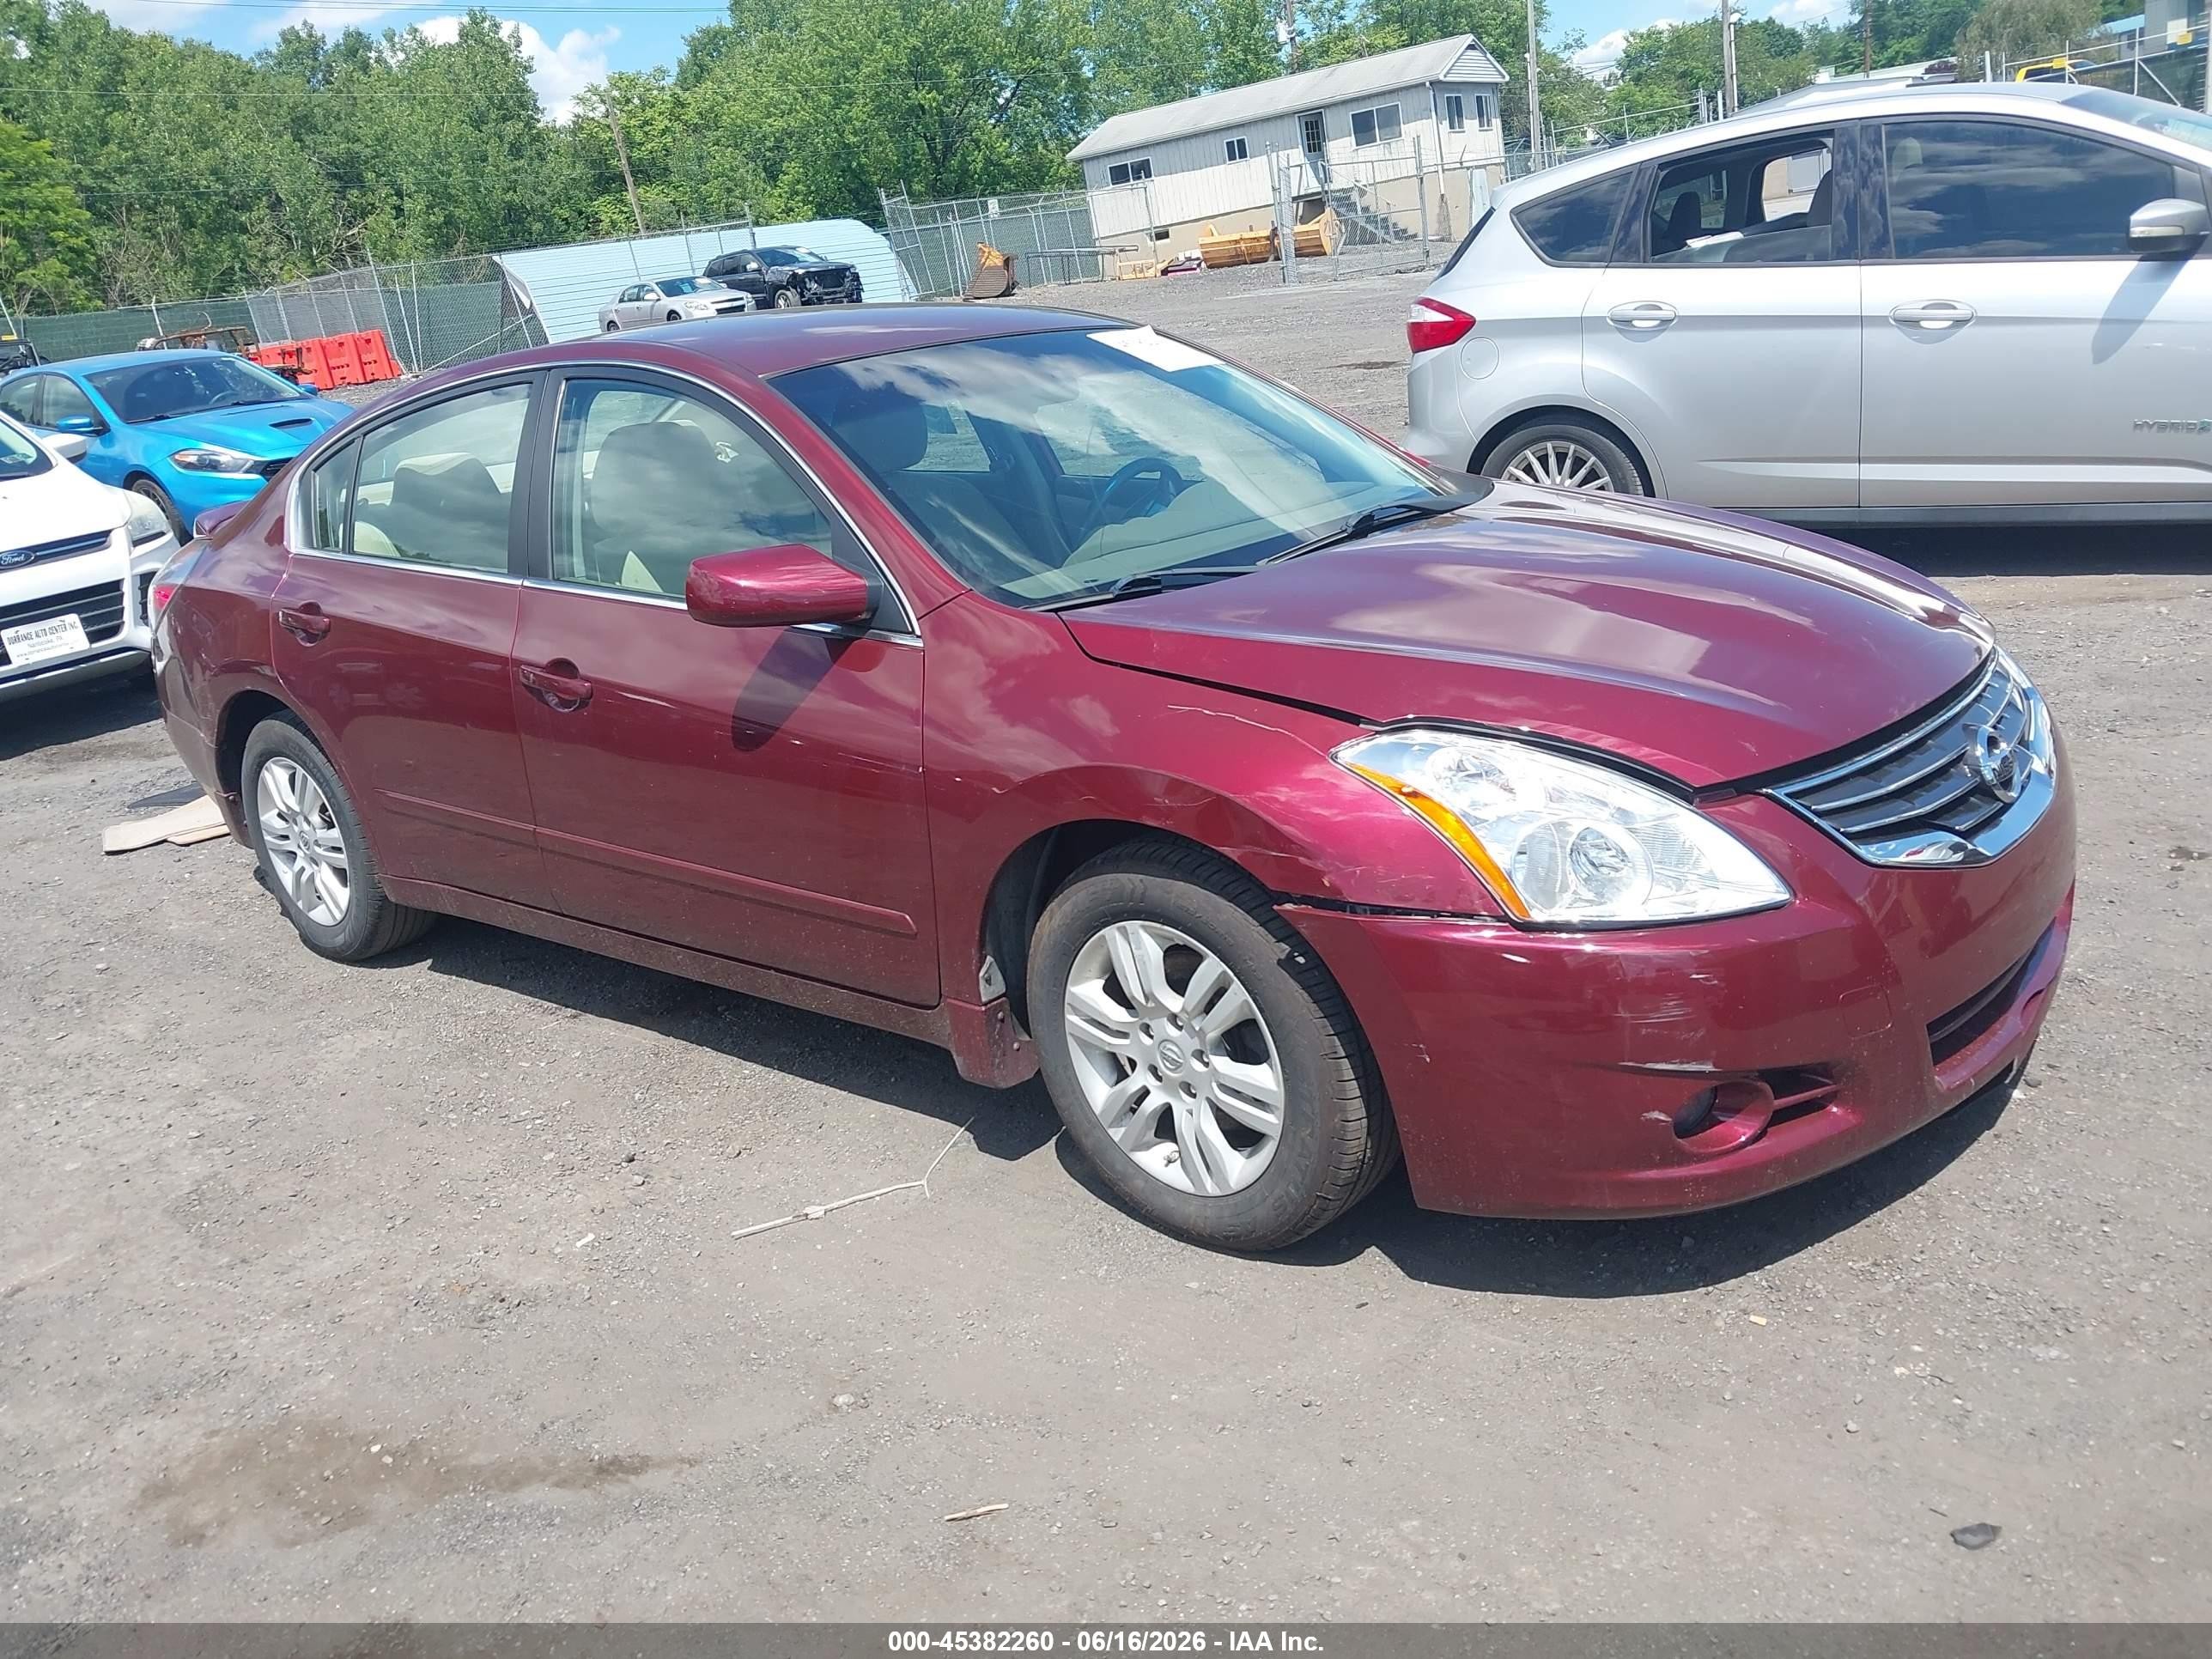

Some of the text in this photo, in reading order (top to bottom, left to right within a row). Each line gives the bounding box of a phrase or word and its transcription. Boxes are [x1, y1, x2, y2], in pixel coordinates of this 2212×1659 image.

[2133, 419, 2198, 433] HYBRID
[1, 553, 25, 565] Ford
[34, 628, 48, 639] AUTO
[48, 623, 68, 635] CENTER
